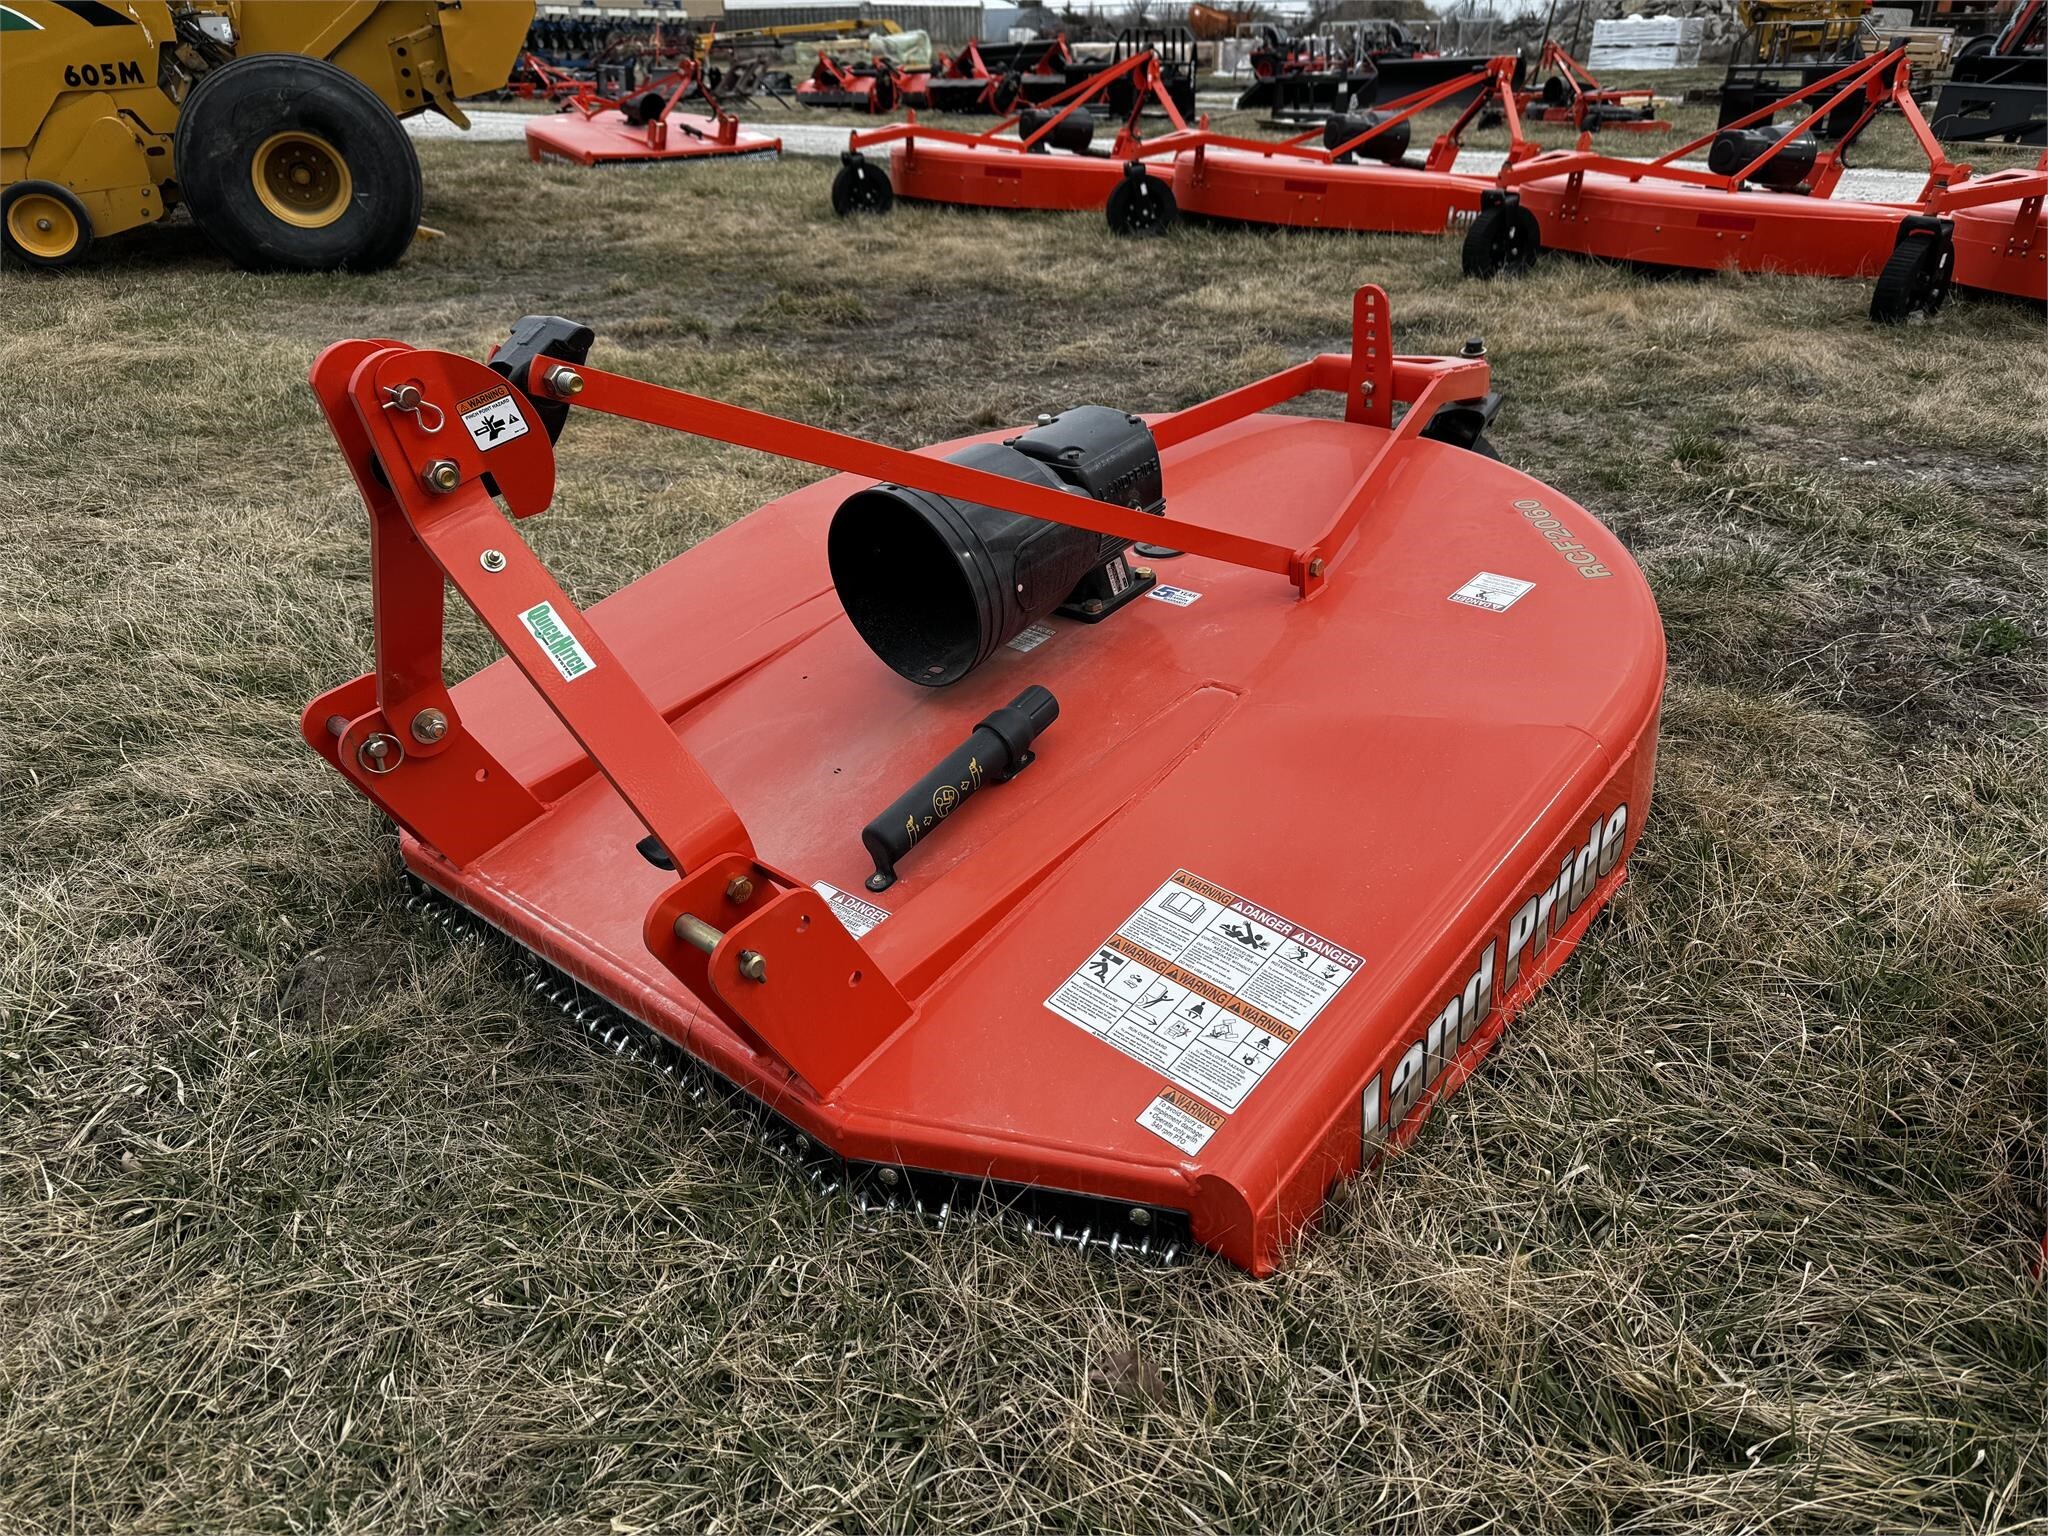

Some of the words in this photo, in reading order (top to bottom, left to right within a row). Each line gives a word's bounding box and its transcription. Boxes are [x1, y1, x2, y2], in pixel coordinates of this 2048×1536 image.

[64, 61, 145, 87] 605M
[1447, 205, 1482, 226] Lan
[465, 411, 479, 421] PINCH
[479, 406, 492, 415] POINT
[492, 398, 510, 409] HAZARD
[466, 387, 505, 408] WARNING
[1513, 499, 1614, 579] RCF2060
[1152, 586, 1181, 598] 5
[1452, 594, 1492, 608] DANGER
[844, 898, 889, 923] DANGER
[1186, 877, 1232, 905] WARNING
[1241, 904, 1294, 935] DANGER
[1303, 935, 1360, 969] DANGER
[1121, 942, 1168, 972] WARNING
[1179, 972, 1229, 1004] WARNING
[1242, 1006, 1294, 1041] WARNING
[1361, 936, 1497, 1161] Land
[1503, 802, 1628, 993] Pride
[1158, 1100, 1166, 1108] To
[1166, 1104, 1183, 1117] avoid
[1180, 1112, 1197, 1127] injury
[1175, 1094, 1220, 1127] WARNING
[1151, 1121, 1163, 1130] 540
[1161, 1127, 1174, 1138] rpm
[1172, 1133, 1187, 1144] PTO
[1152, 1113, 1173, 1129] Operate
[1173, 1125, 1185, 1136] only
[1185, 1133, 1198, 1143] with
